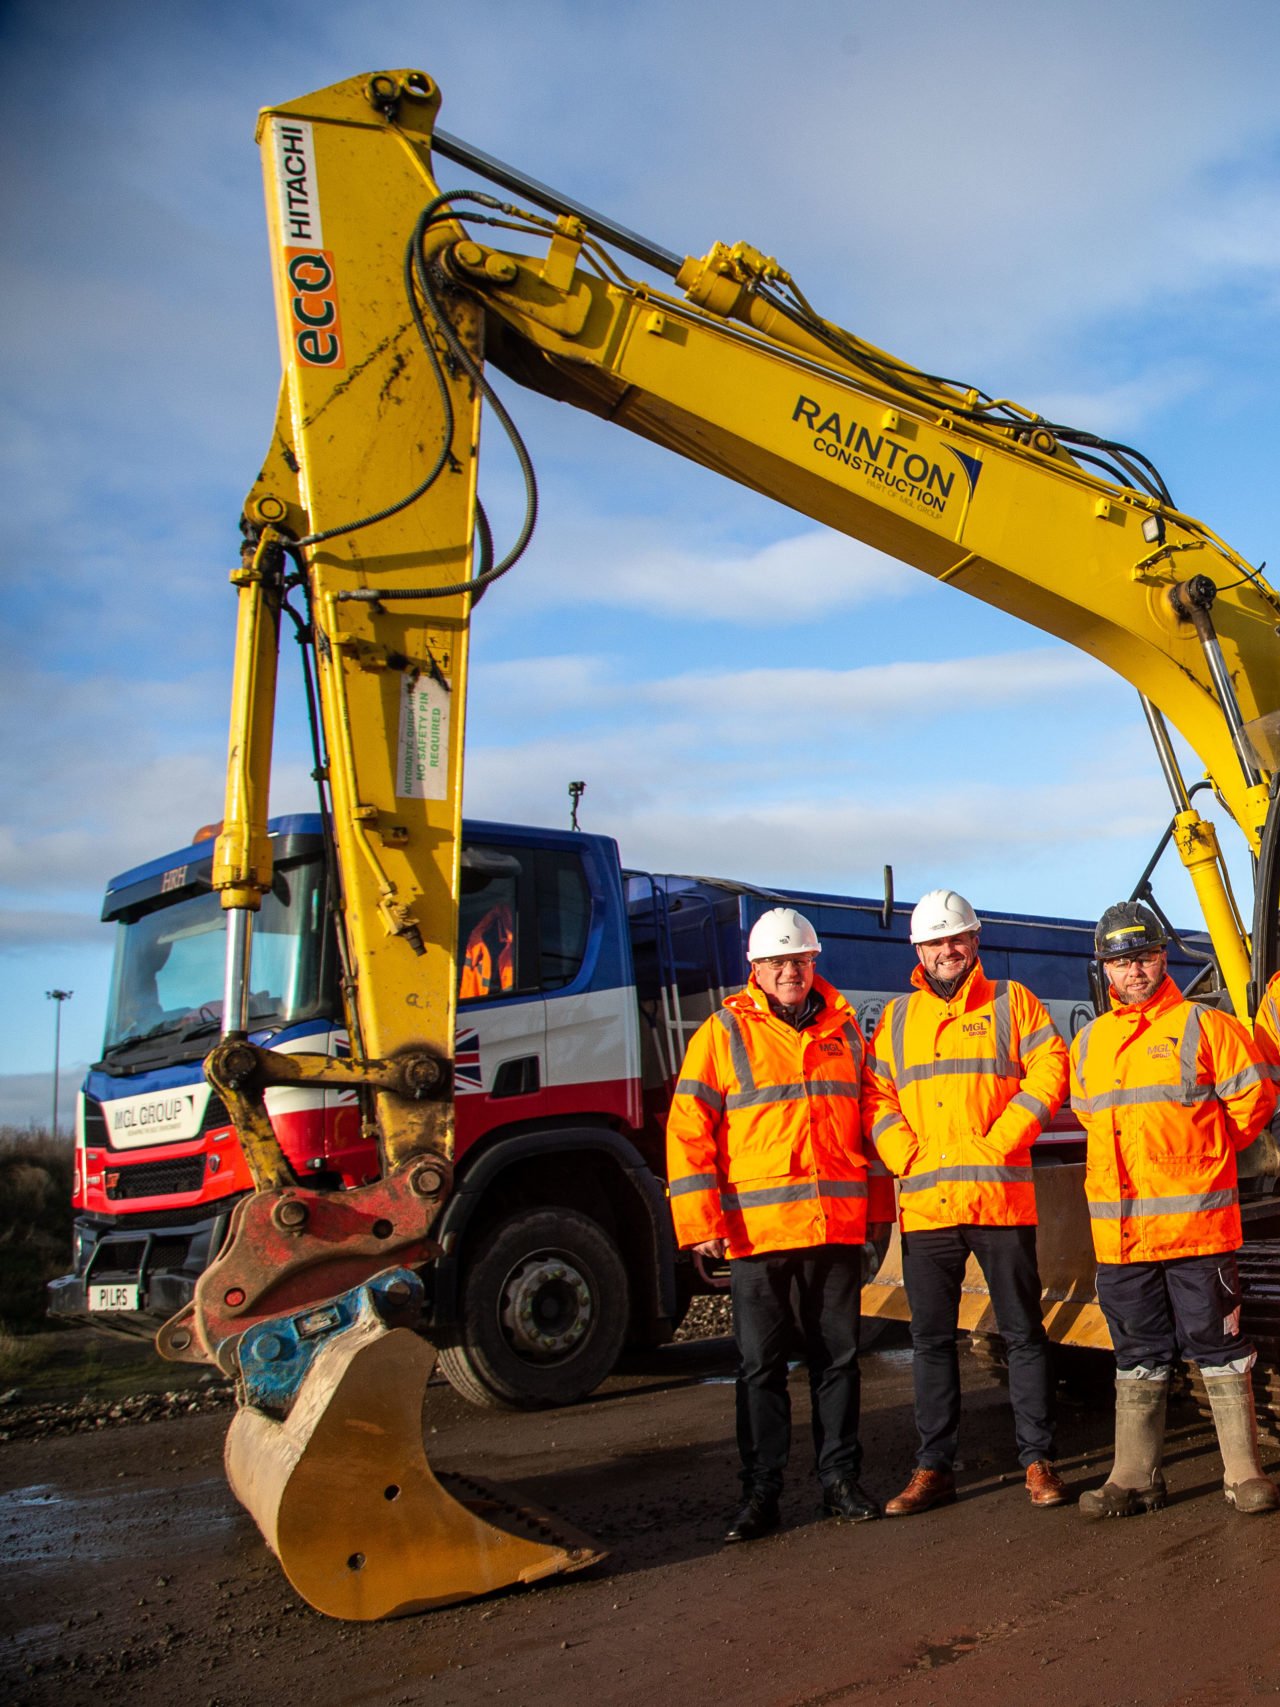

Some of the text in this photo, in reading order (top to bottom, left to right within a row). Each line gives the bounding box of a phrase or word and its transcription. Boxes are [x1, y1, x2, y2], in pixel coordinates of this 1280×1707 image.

[281, 126, 312, 239] HITACHI
[792, 395, 955, 498] RAINTON
[813, 437, 946, 512] CONSTRUCTION
[407, 708, 415, 738] QUICK
[416, 692, 429, 781] NO SAFETY PIN
[430, 708, 441, 768] REQUIRED
[404, 742, 414, 795] AUTOMATIC
[819, 1042, 841, 1052] MGL
[962, 1022, 986, 1032] MGL
[1147, 1043, 1171, 1055] MGL
[114, 1106, 137, 1130] MGL
[140, 1099, 182, 1125] GROUP
